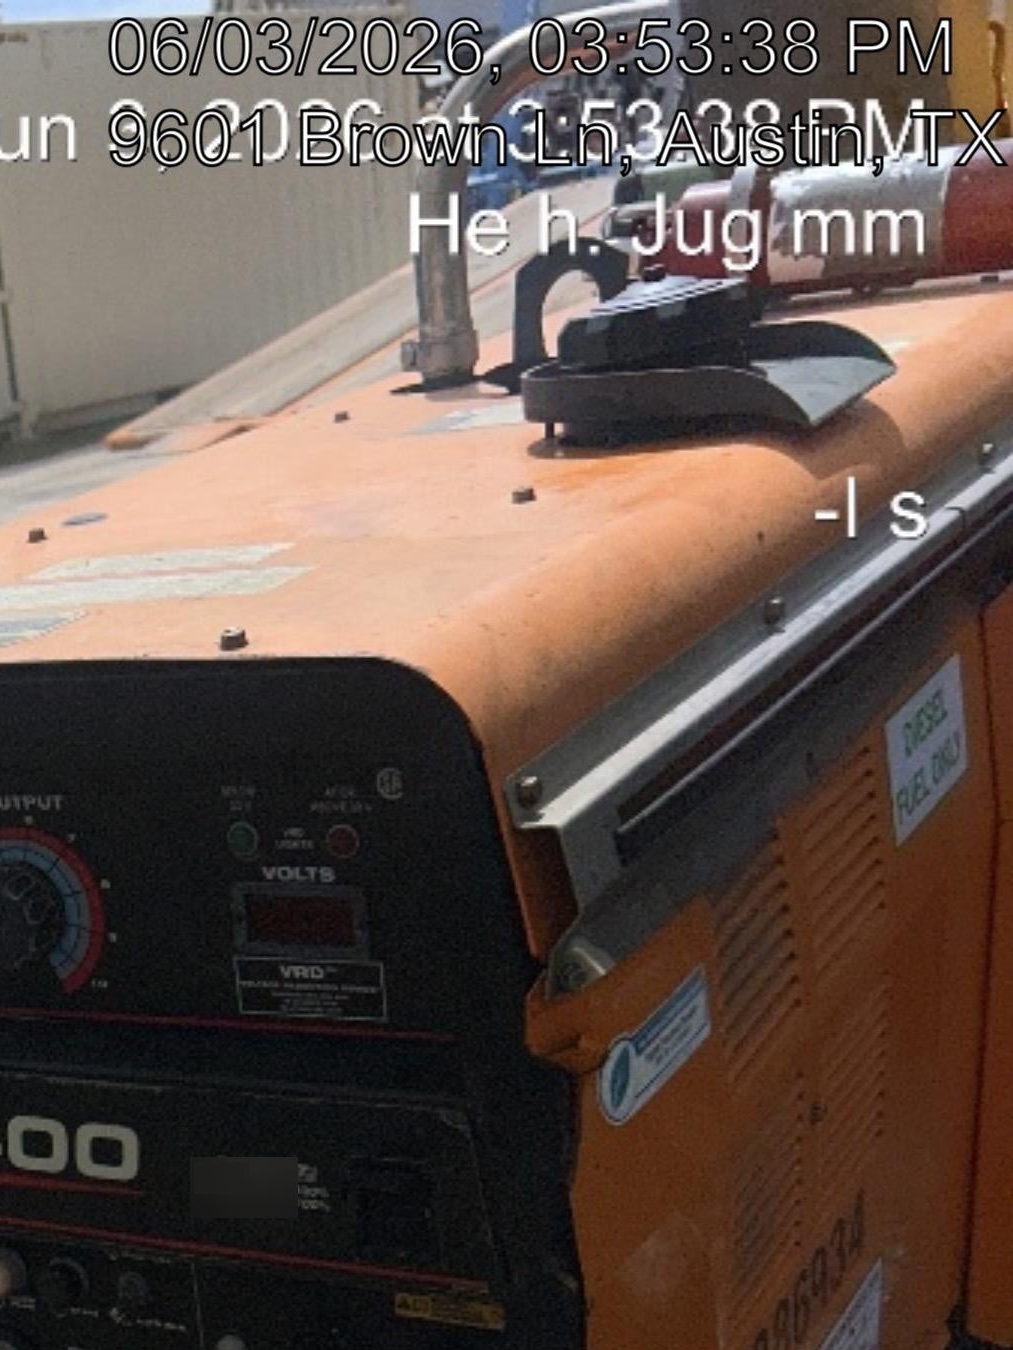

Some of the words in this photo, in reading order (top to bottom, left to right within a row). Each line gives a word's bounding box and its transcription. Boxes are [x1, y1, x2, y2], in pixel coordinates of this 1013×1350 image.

[903, 689, 949, 758] DIESEL
[895, 766, 931, 826] FUEL
[261, 865, 336, 883] VOLTS
